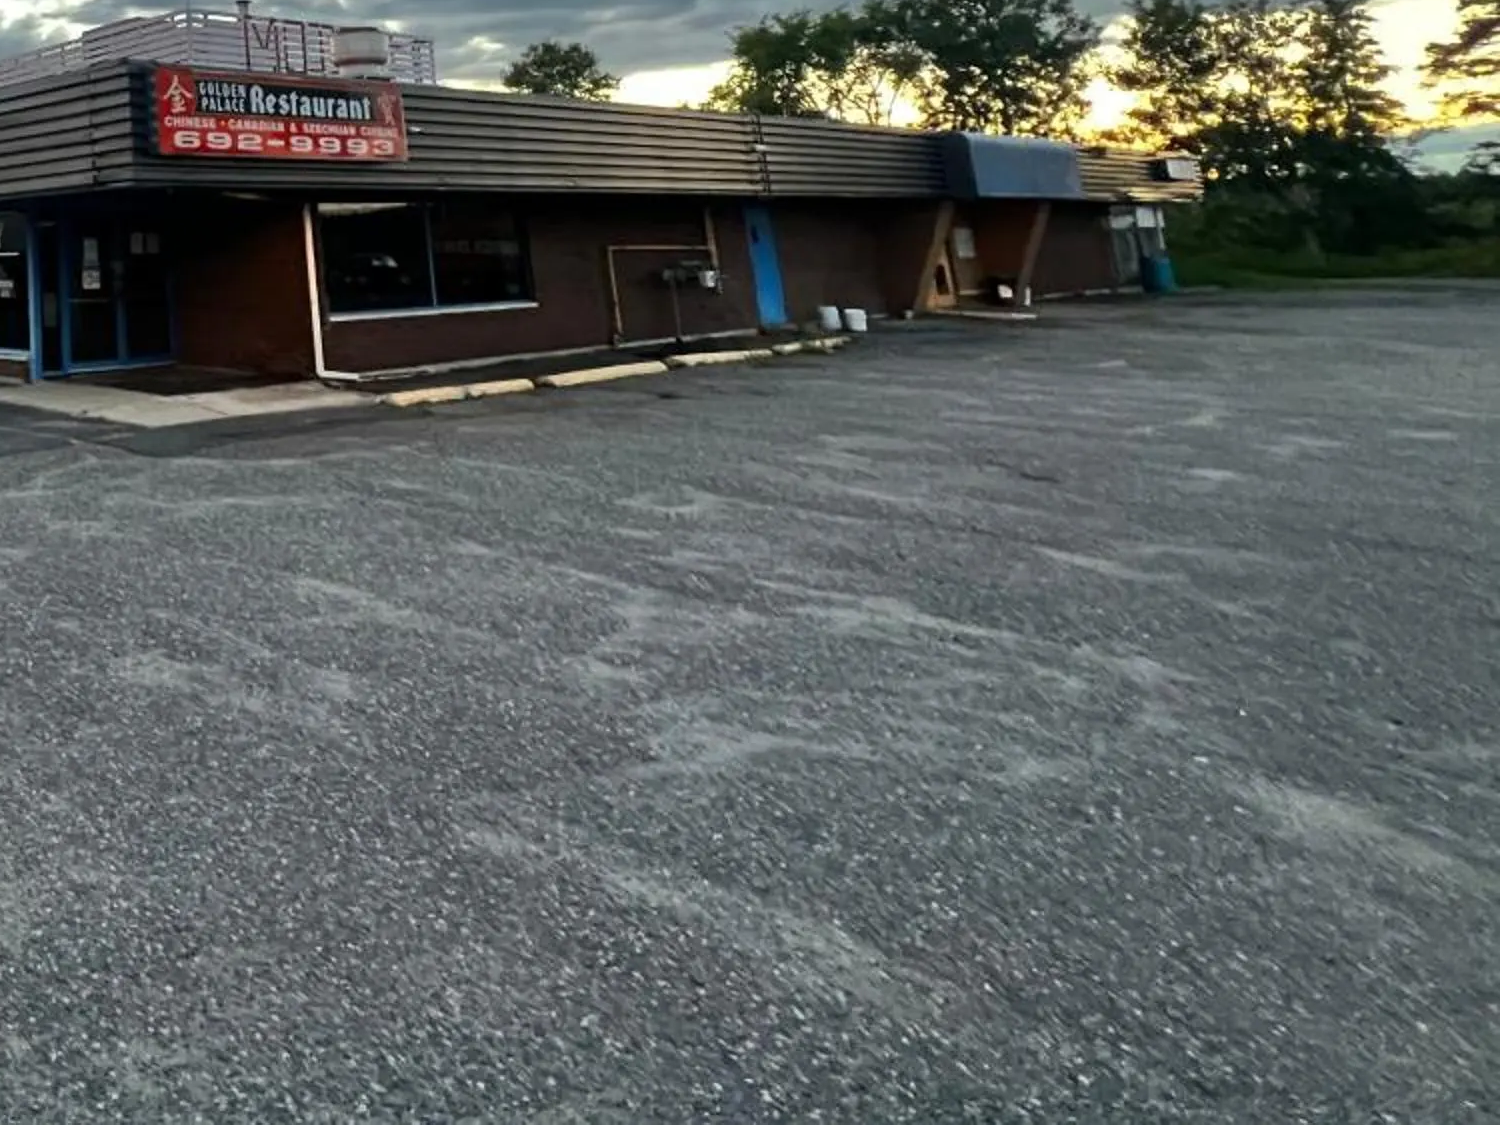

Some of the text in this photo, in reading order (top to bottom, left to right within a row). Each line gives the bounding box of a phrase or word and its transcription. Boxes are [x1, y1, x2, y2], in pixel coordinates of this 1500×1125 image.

[198, 81, 247, 97] GOLDEN
[201, 96, 246, 112] PALACE
[249, 84, 371, 120] Restaurant
[164, 115, 217, 130] CHINESE
[227, 118, 285, 133] CANADIAN
[173, 130, 395, 155] 692-9993
